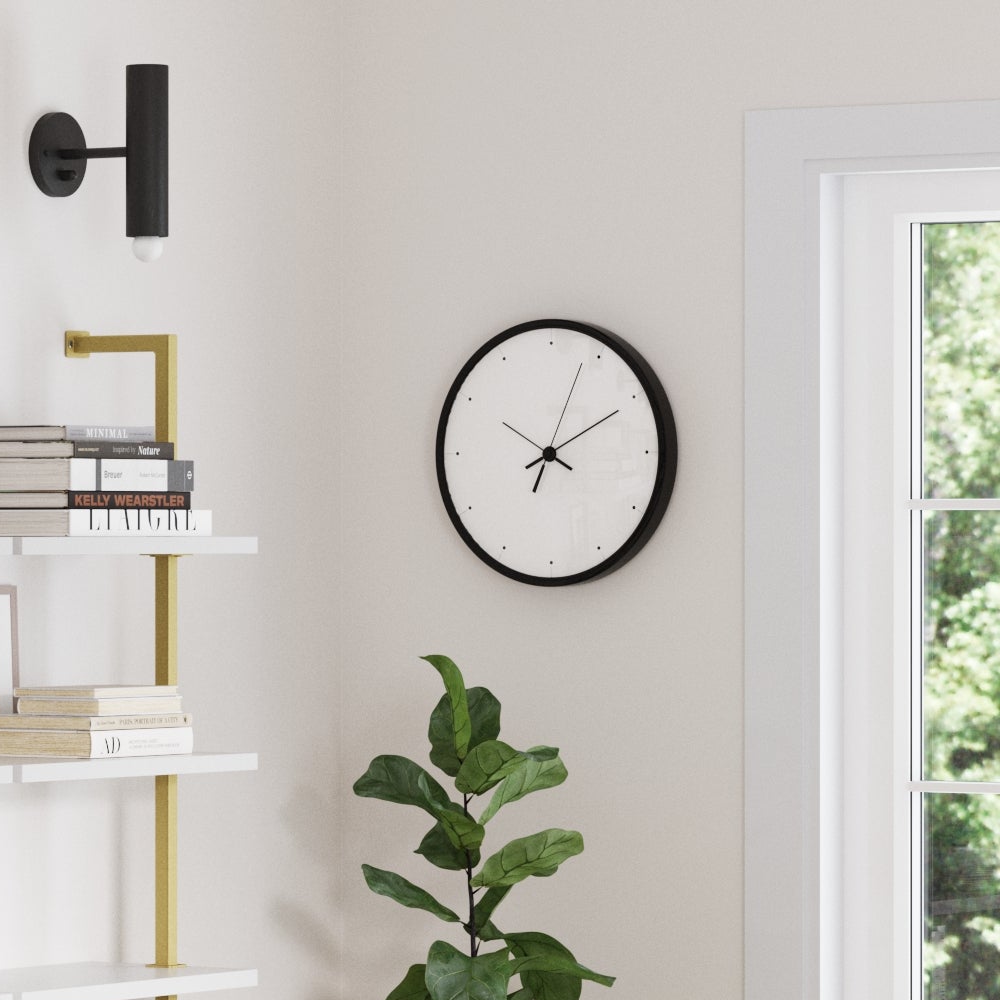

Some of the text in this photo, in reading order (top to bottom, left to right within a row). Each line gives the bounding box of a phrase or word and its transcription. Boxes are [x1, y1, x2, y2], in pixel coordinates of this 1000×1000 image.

[86, 427, 129, 439] MINIMAL
[137, 445, 161, 456] Nature
[74, 494, 185, 507] KELLY WEARSTLER
